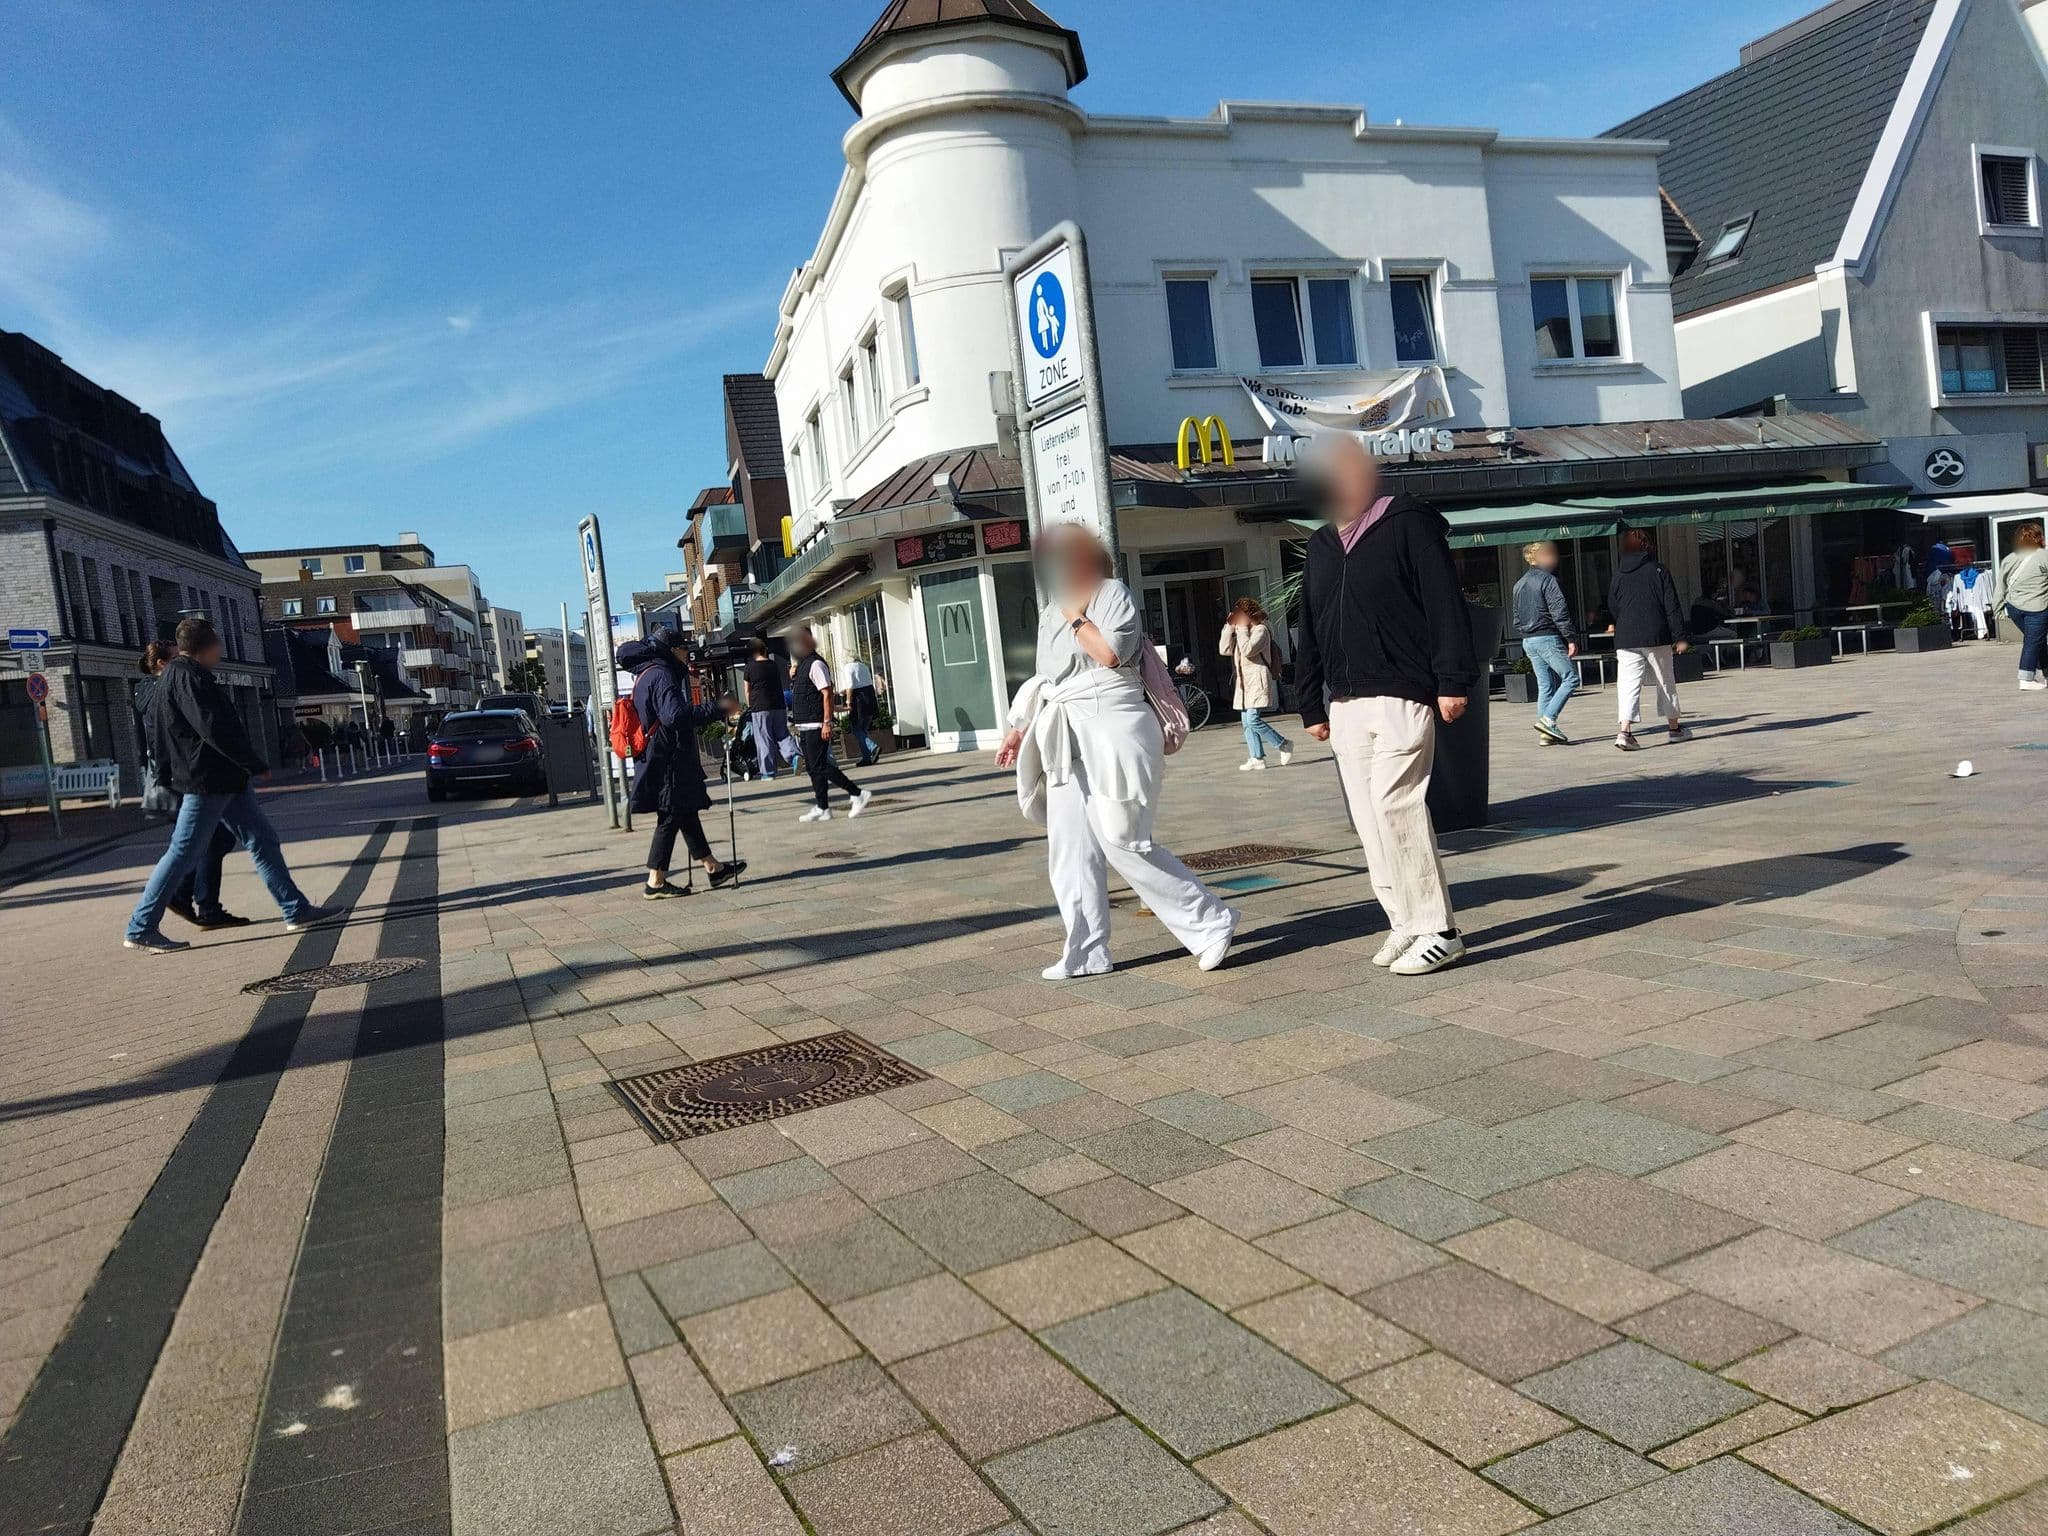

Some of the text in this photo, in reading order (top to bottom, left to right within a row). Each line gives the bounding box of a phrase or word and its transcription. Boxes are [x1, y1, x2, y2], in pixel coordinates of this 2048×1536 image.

[1039, 357, 1069, 390] ZONE
[1276, 400, 1308, 416] Job:
[1041, 424, 1080, 452] Lieferverkehr
[1056, 450, 1071, 469] frei
[1047, 481, 1061, 495] von
[1063, 469, 1079, 490] 7-10
[1061, 495, 1075, 514] und
